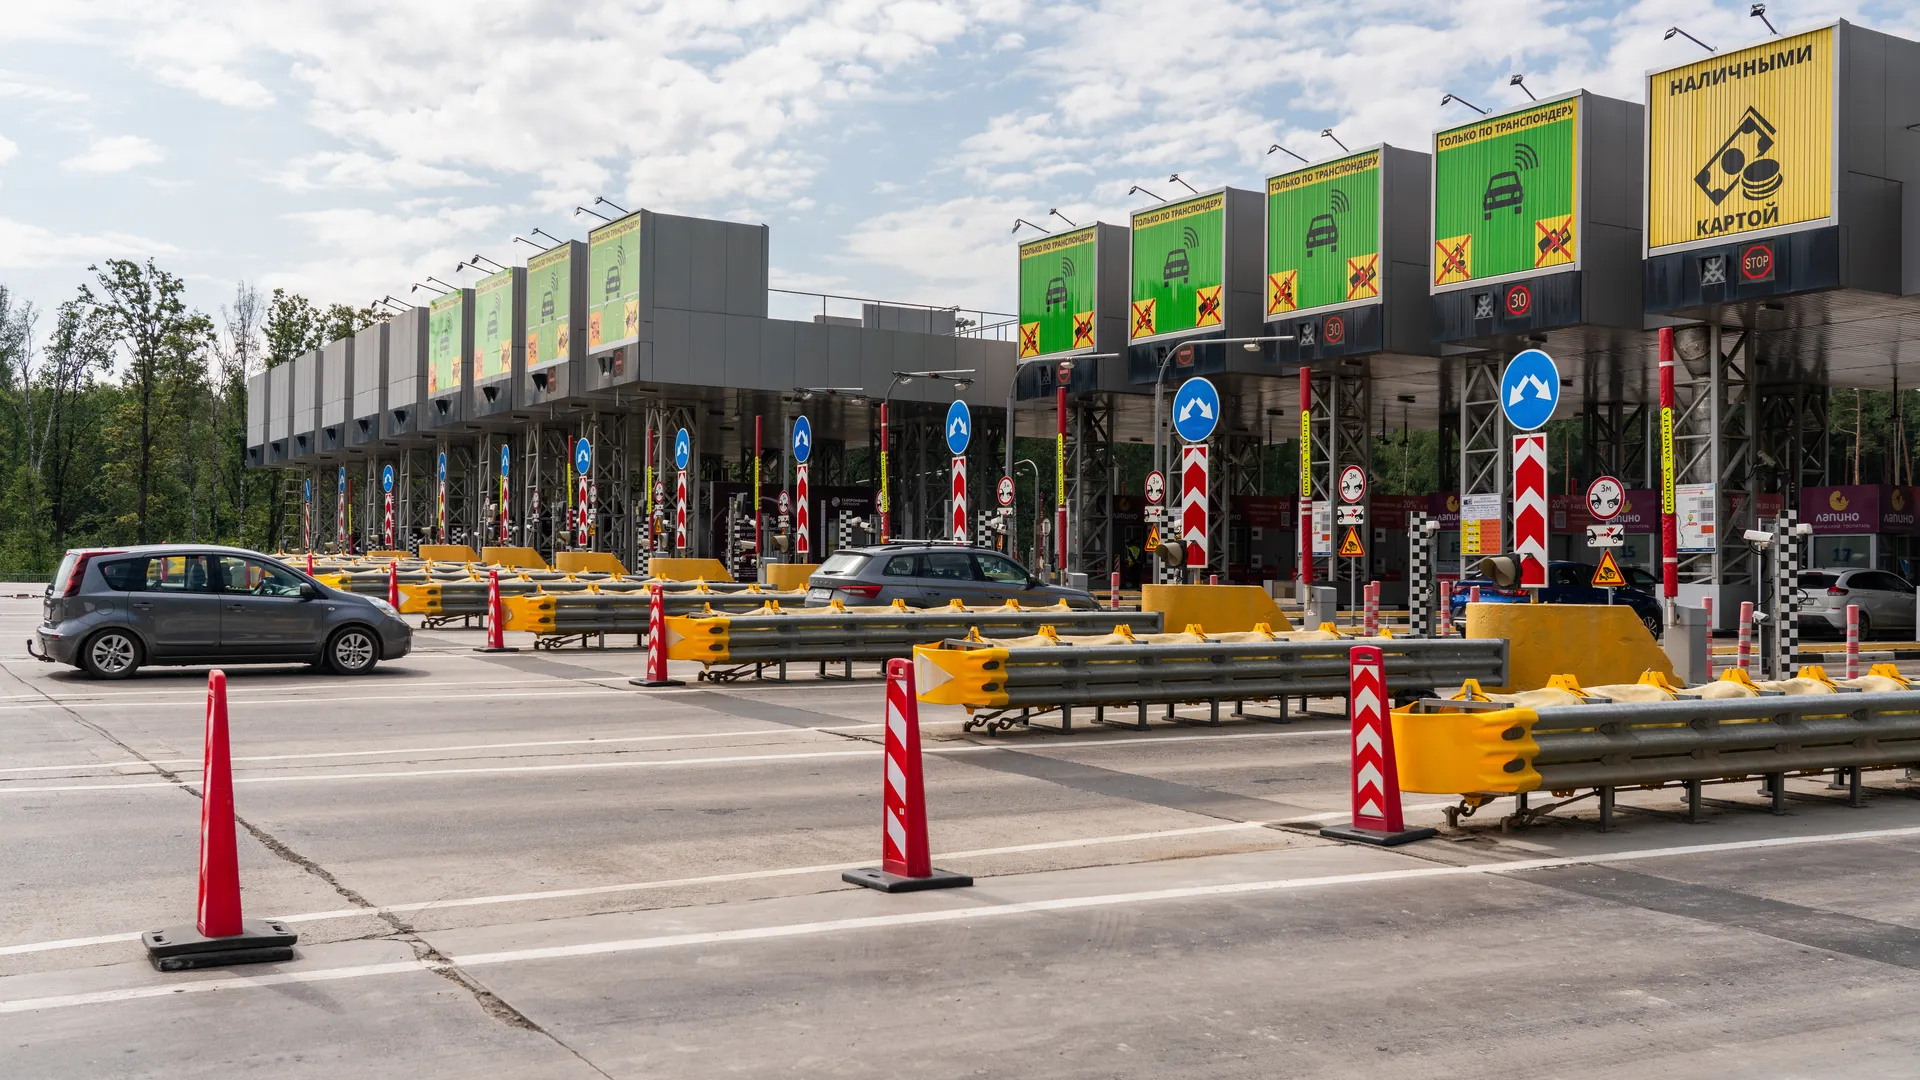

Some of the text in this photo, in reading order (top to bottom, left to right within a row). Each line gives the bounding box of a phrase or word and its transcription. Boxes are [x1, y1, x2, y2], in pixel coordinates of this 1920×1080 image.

[1671, 45, 1812, 96] НАЛИЧНЫМИ
[1439, 104, 1574, 148] ТОЛЬКО ПО ТРАНСПОНДЕРУ
[1270, 155, 1379, 192] ТОЛЬКО ПО ТРАНСПОНДЕРУ
[1135, 197, 1223, 228] ТОЛЬКО ПО ТРАНСПОНДЕРУ
[1697, 202, 1778, 236] КАРТОЙ
[1021, 231, 1094, 256] ТОЛЬКО ПО ТРАНСПОНДЕРУ
[1745, 255, 1769, 270] STOP
[1511, 292, 1527, 308] 30
[1328, 322, 1340, 337] 30
[1663, 410, 1671, 462] ЗАКРЫТА
[1833, 548, 1852, 562] 17
